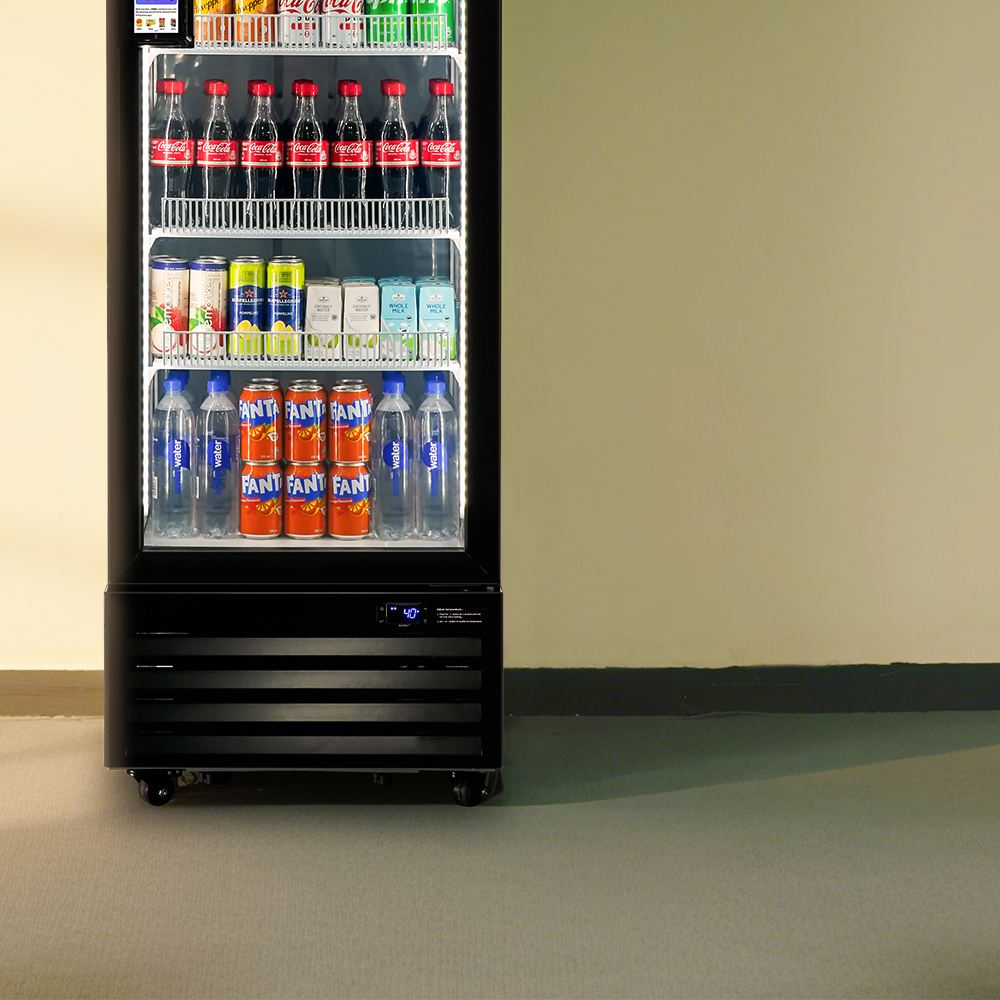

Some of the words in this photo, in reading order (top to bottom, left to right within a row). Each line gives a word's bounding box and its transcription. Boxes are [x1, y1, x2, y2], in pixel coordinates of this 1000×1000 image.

[239, 398, 280, 420] FANTA
[284, 398, 327, 421] FANTA
[172, 439, 182, 468] water
[213, 440, 222, 468] water
[391, 441, 400, 469] water
[428, 441, 438, 470] water
[241, 473, 282, 495] FANT
[286, 473, 326, 496] FANT
[332, 473, 371, 496] FANT
